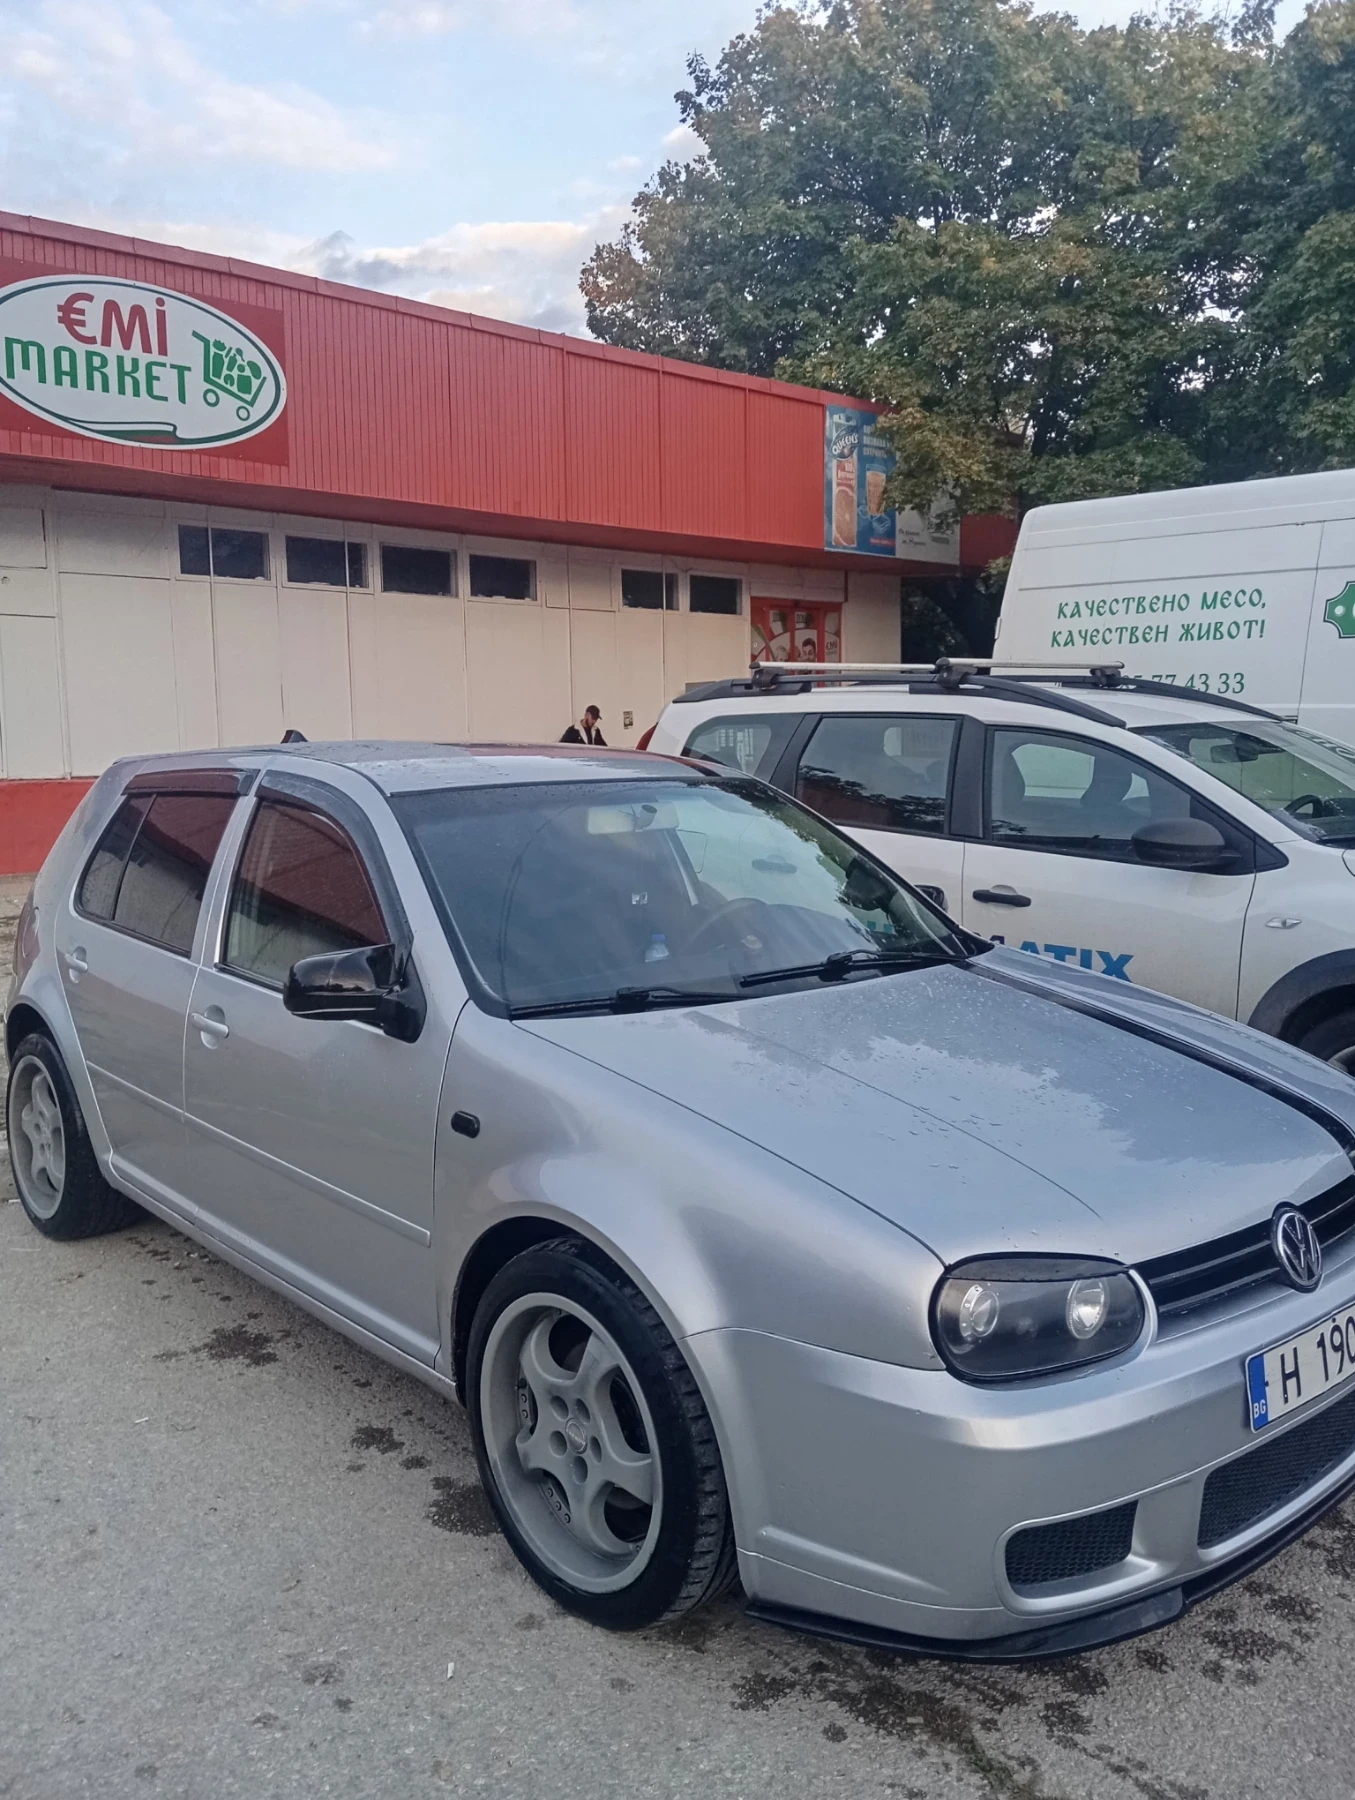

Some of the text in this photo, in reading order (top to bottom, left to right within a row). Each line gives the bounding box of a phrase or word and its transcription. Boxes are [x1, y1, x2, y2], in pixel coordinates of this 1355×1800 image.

[4, 336, 192, 405] MARKET
[1057, 593, 1190, 619] КАЧЕСТВЕНО
[1050, 619, 1266, 648] КАЧЕСТВЕН ЖИВОТ!
[1217, 672, 1245, 694] 33
[1280, 1346, 1302, 1405] H
[1253, 1399, 1266, 1418] BG
